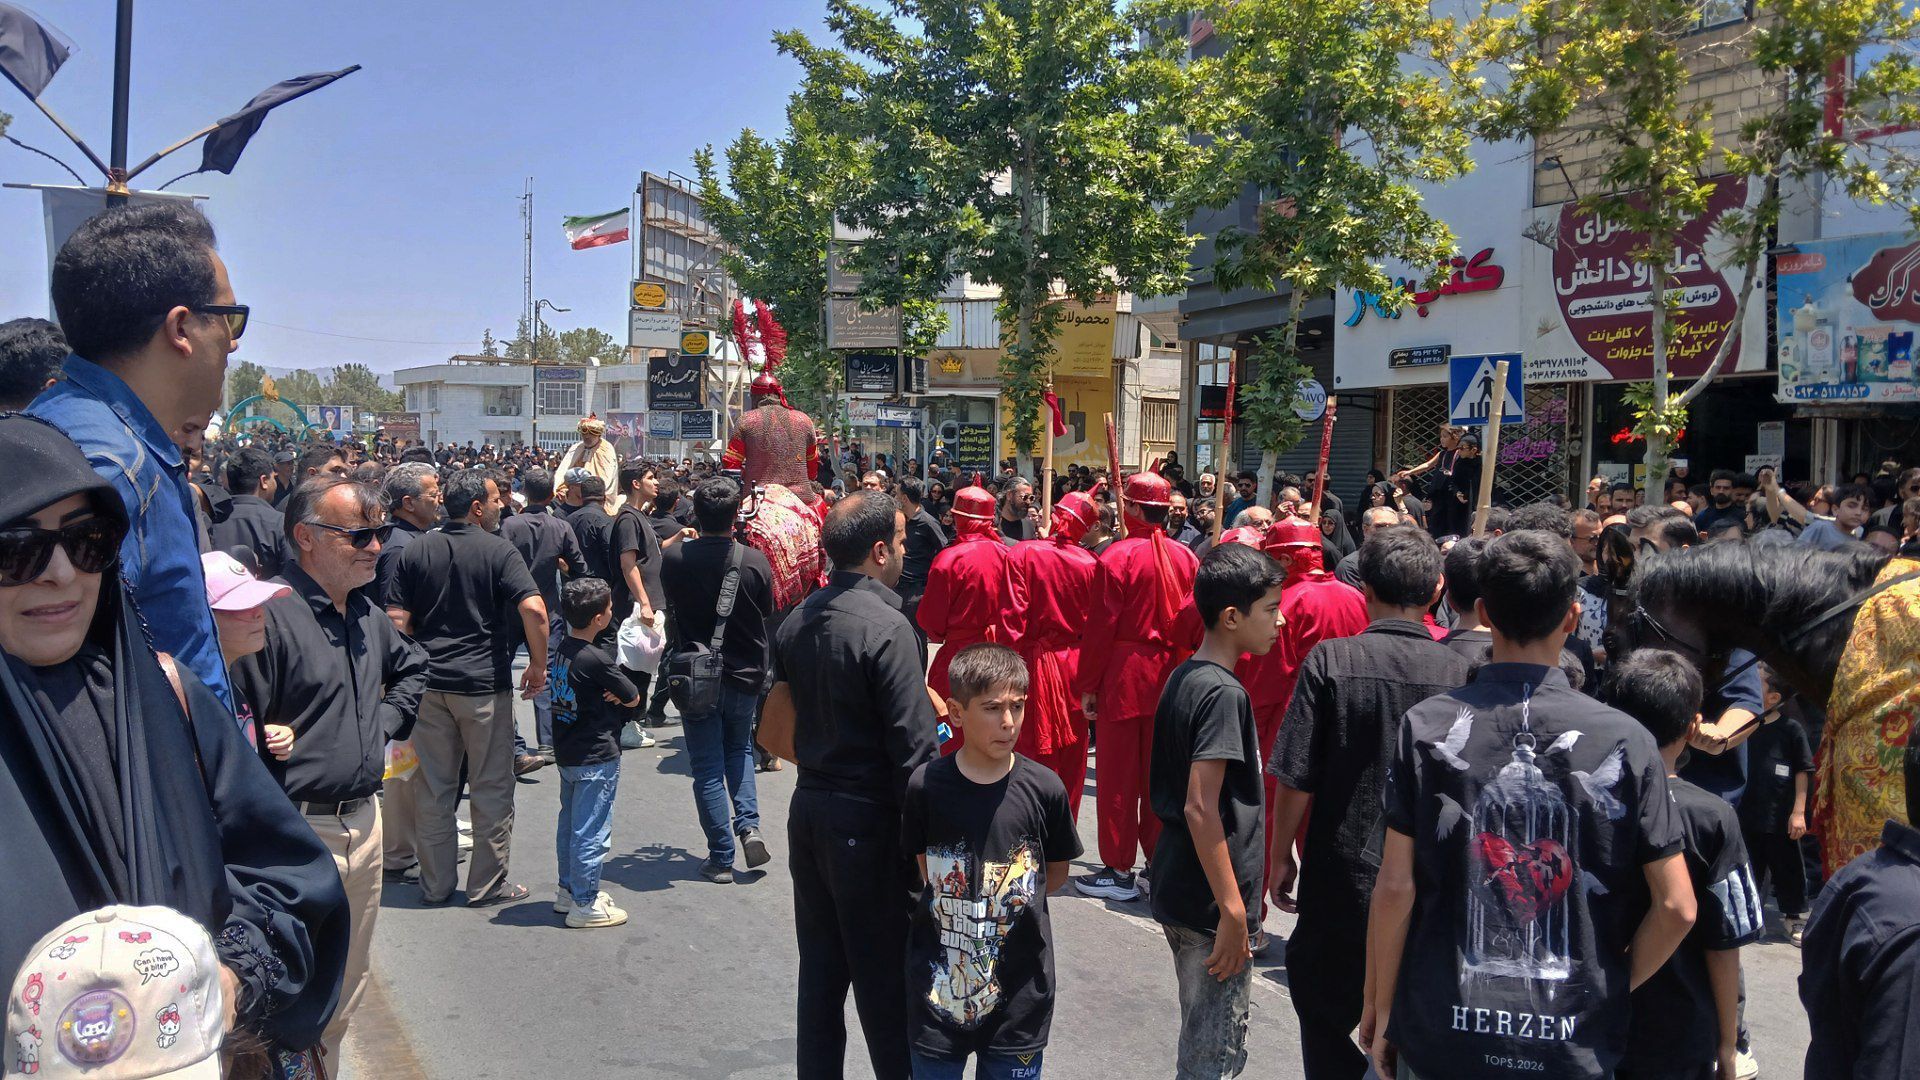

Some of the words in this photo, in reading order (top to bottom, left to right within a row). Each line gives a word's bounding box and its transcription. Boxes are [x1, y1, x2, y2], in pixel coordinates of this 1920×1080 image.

[1556, 256, 1631, 295] دانش
[1686, 288, 1719, 303] فروش
[1569, 299, 1614, 316] دانشجویی
[1614, 298, 1635, 311] های
[1689, 320, 1718, 339] تایپ
[1606, 345, 1642, 360] جزوات
[959, 425, 990, 435] فروش
[151, 963, 167, 971] bite?
[1451, 1005, 1576, 1040] HERZEN
[1484, 1054, 1545, 1071] TOPS.2026
[1011, 1065, 1037, 1078] TEAM
